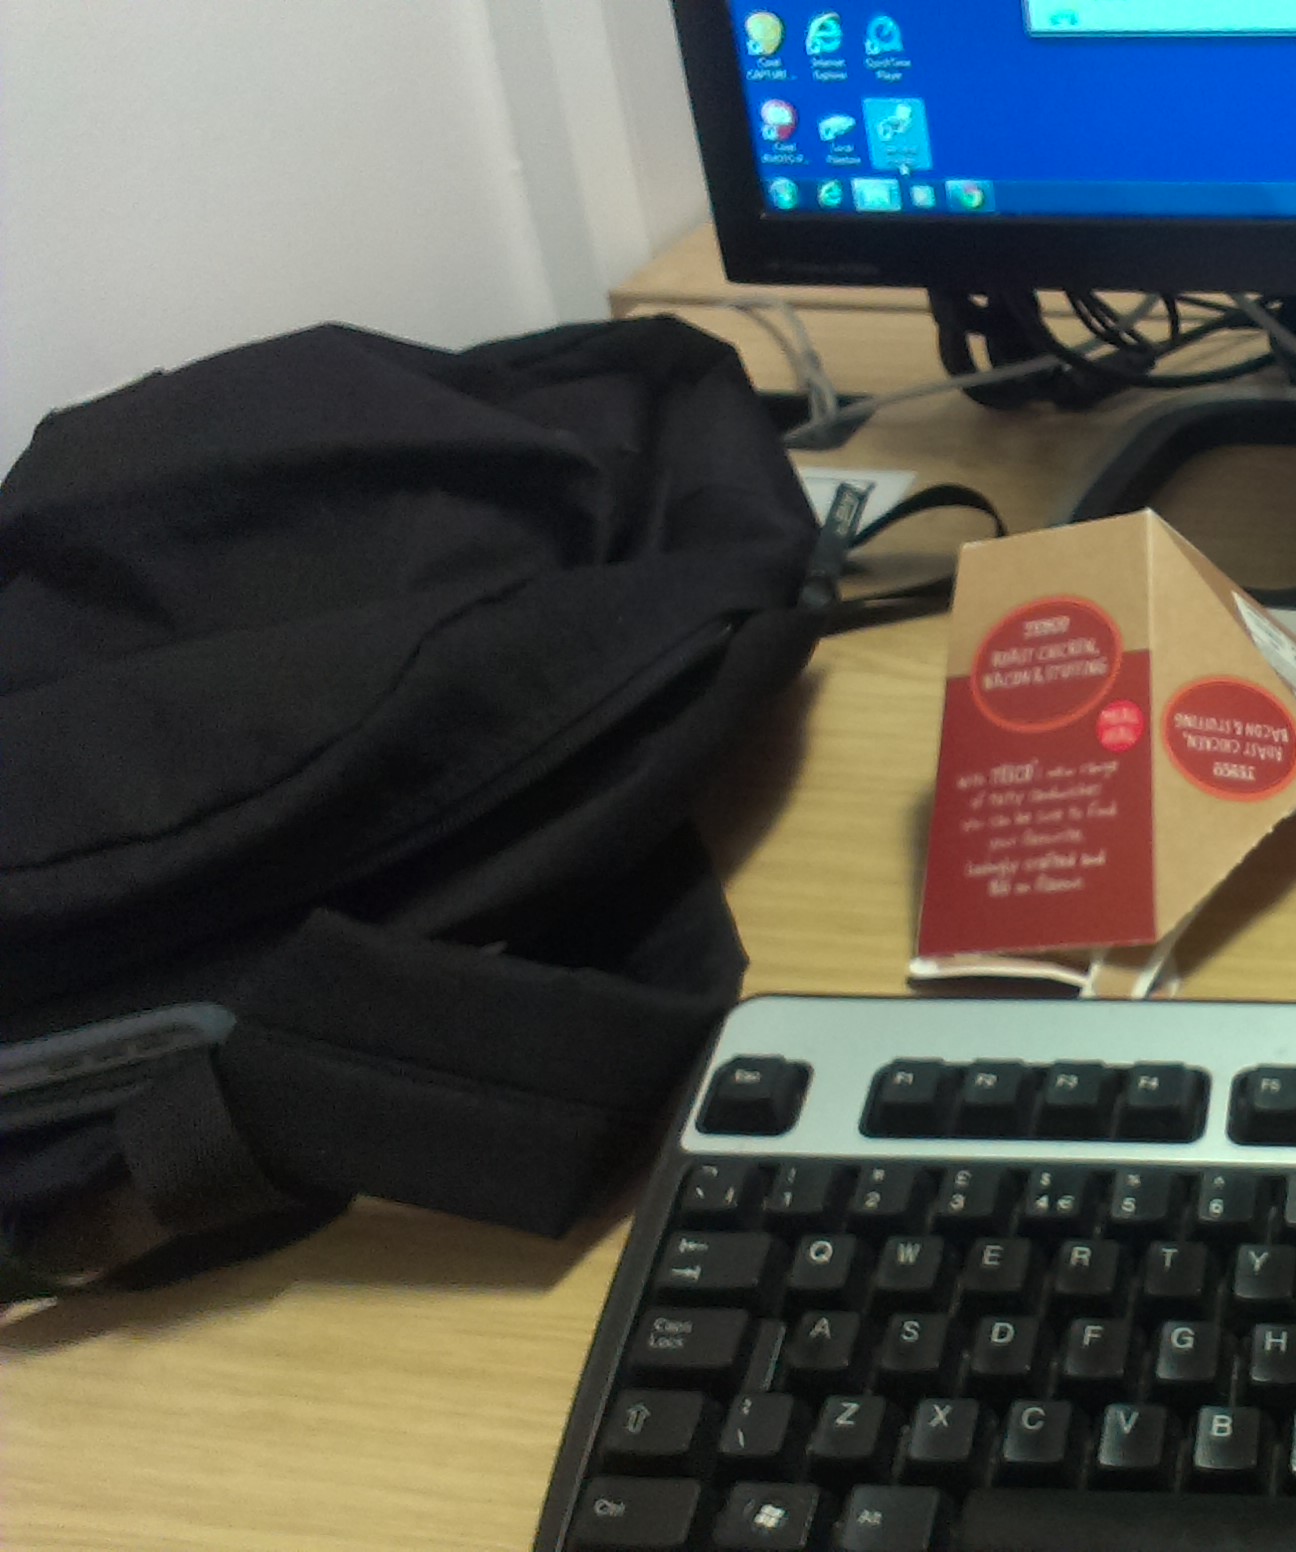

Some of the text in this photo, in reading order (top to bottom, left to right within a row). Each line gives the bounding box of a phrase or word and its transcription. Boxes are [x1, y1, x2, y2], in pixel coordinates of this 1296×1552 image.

[1174, 712, 1289, 743] BACON & STUFFING
[1242, 742, 1283, 761] ROAST
[1213, 762, 1256, 781] TESCO
[893, 1071, 913, 1085] F1
[974, 1073, 997, 1087] F2
[1056, 1074, 1078, 1088] F3
[1137, 1075, 1160, 1090] F4
[1261, 1078, 1281, 1092] F5
[865, 1192, 880, 1207] 2
[949, 1194, 965, 1209] 3
[1036, 1196, 1049, 1213] 4
[1120, 1197, 1136, 1214] 5
[1209, 1199, 1224, 1215] 6
[809, 1240, 834, 1264] Q
[897, 1242, 921, 1264] W
[982, 1245, 1003, 1265] E
[1070, 1246, 1092, 1268] R
[1161, 1248, 1179, 1270] T
[1249, 1251, 1269, 1274] Y
[809, 1317, 832, 1338] A
[902, 1321, 920, 1341] S
[990, 1323, 1014, 1344] D
[1083, 1326, 1103, 1347] F
[1171, 1328, 1194, 1349] G
[1265, 1330, 1288, 1352] H
[834, 1402, 860, 1426] Z
[929, 1404, 952, 1427] X
[1021, 1407, 1045, 1430] C
[1118, 1411, 1139, 1434] V
[1212, 1415, 1233, 1436] B
